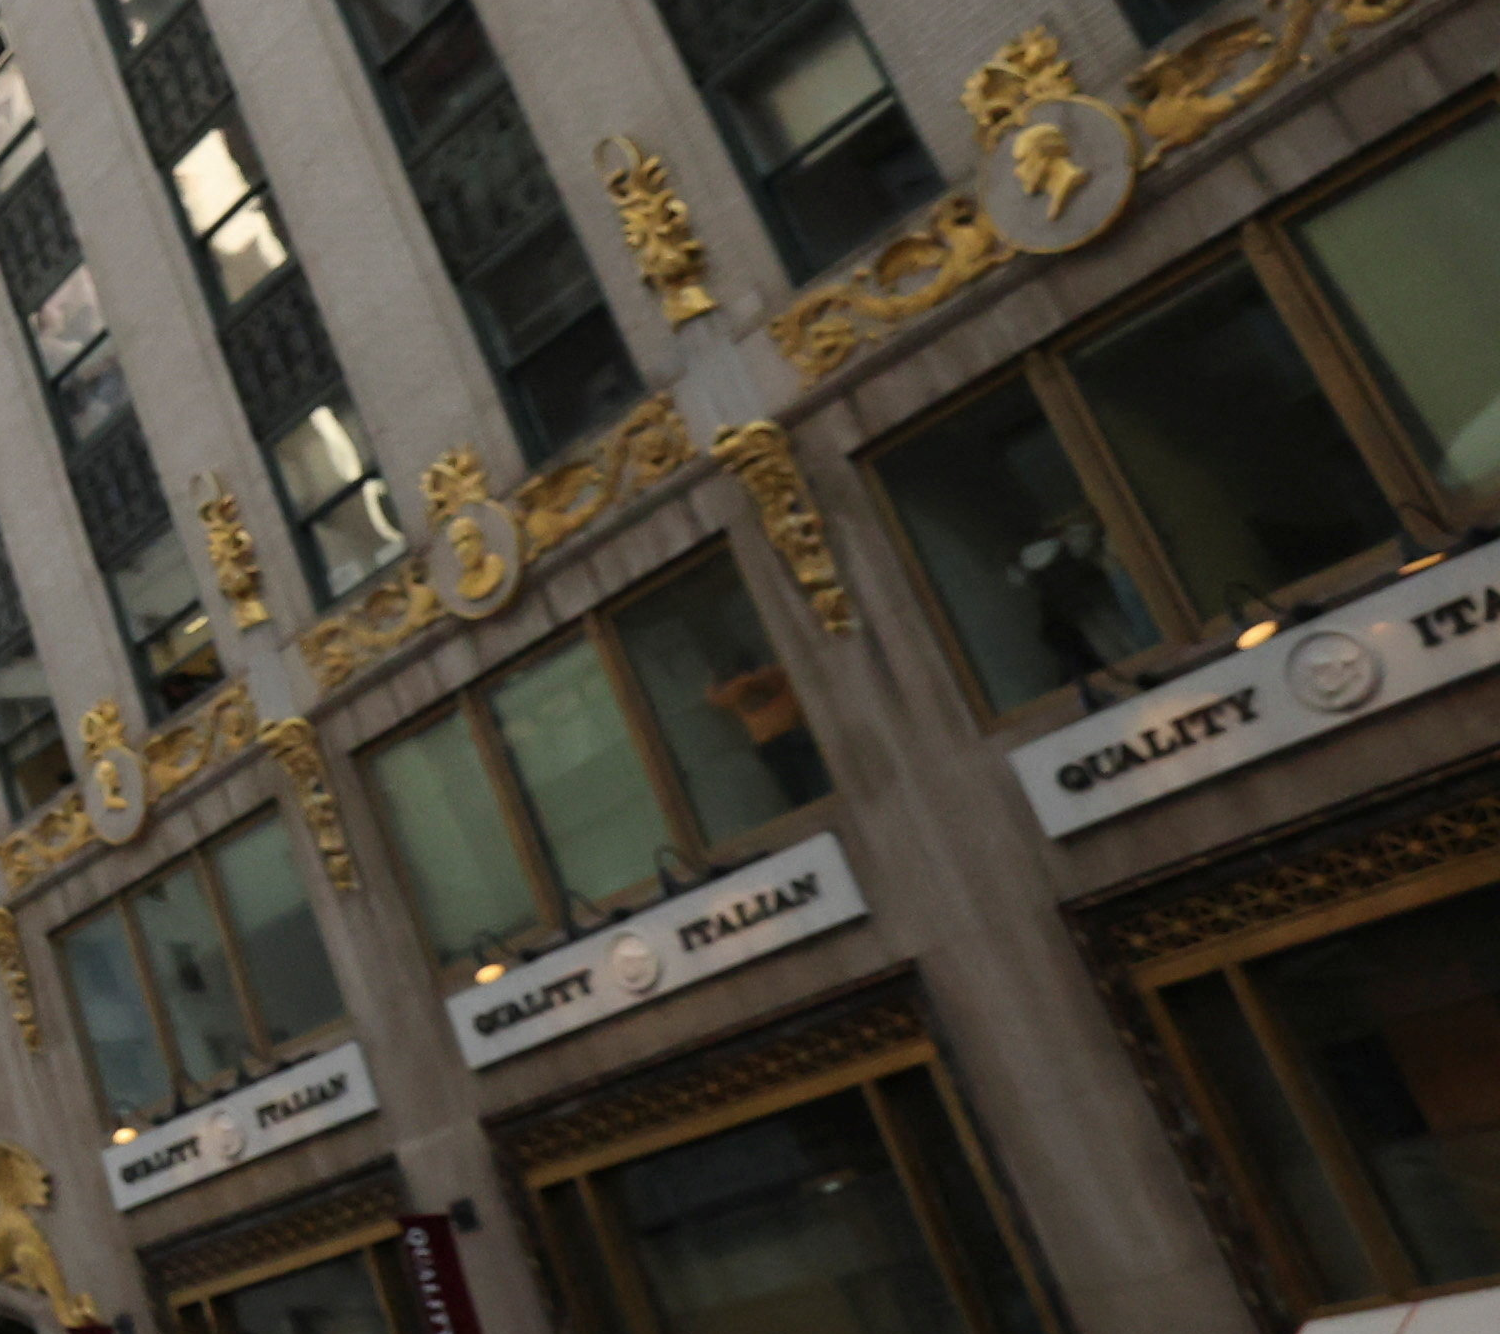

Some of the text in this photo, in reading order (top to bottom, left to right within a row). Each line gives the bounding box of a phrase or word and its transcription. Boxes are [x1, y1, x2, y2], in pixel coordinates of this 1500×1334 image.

[1057, 687, 1259, 791] QUALITY
[472, 873, 820, 1037] QUALITY ITALIAN
